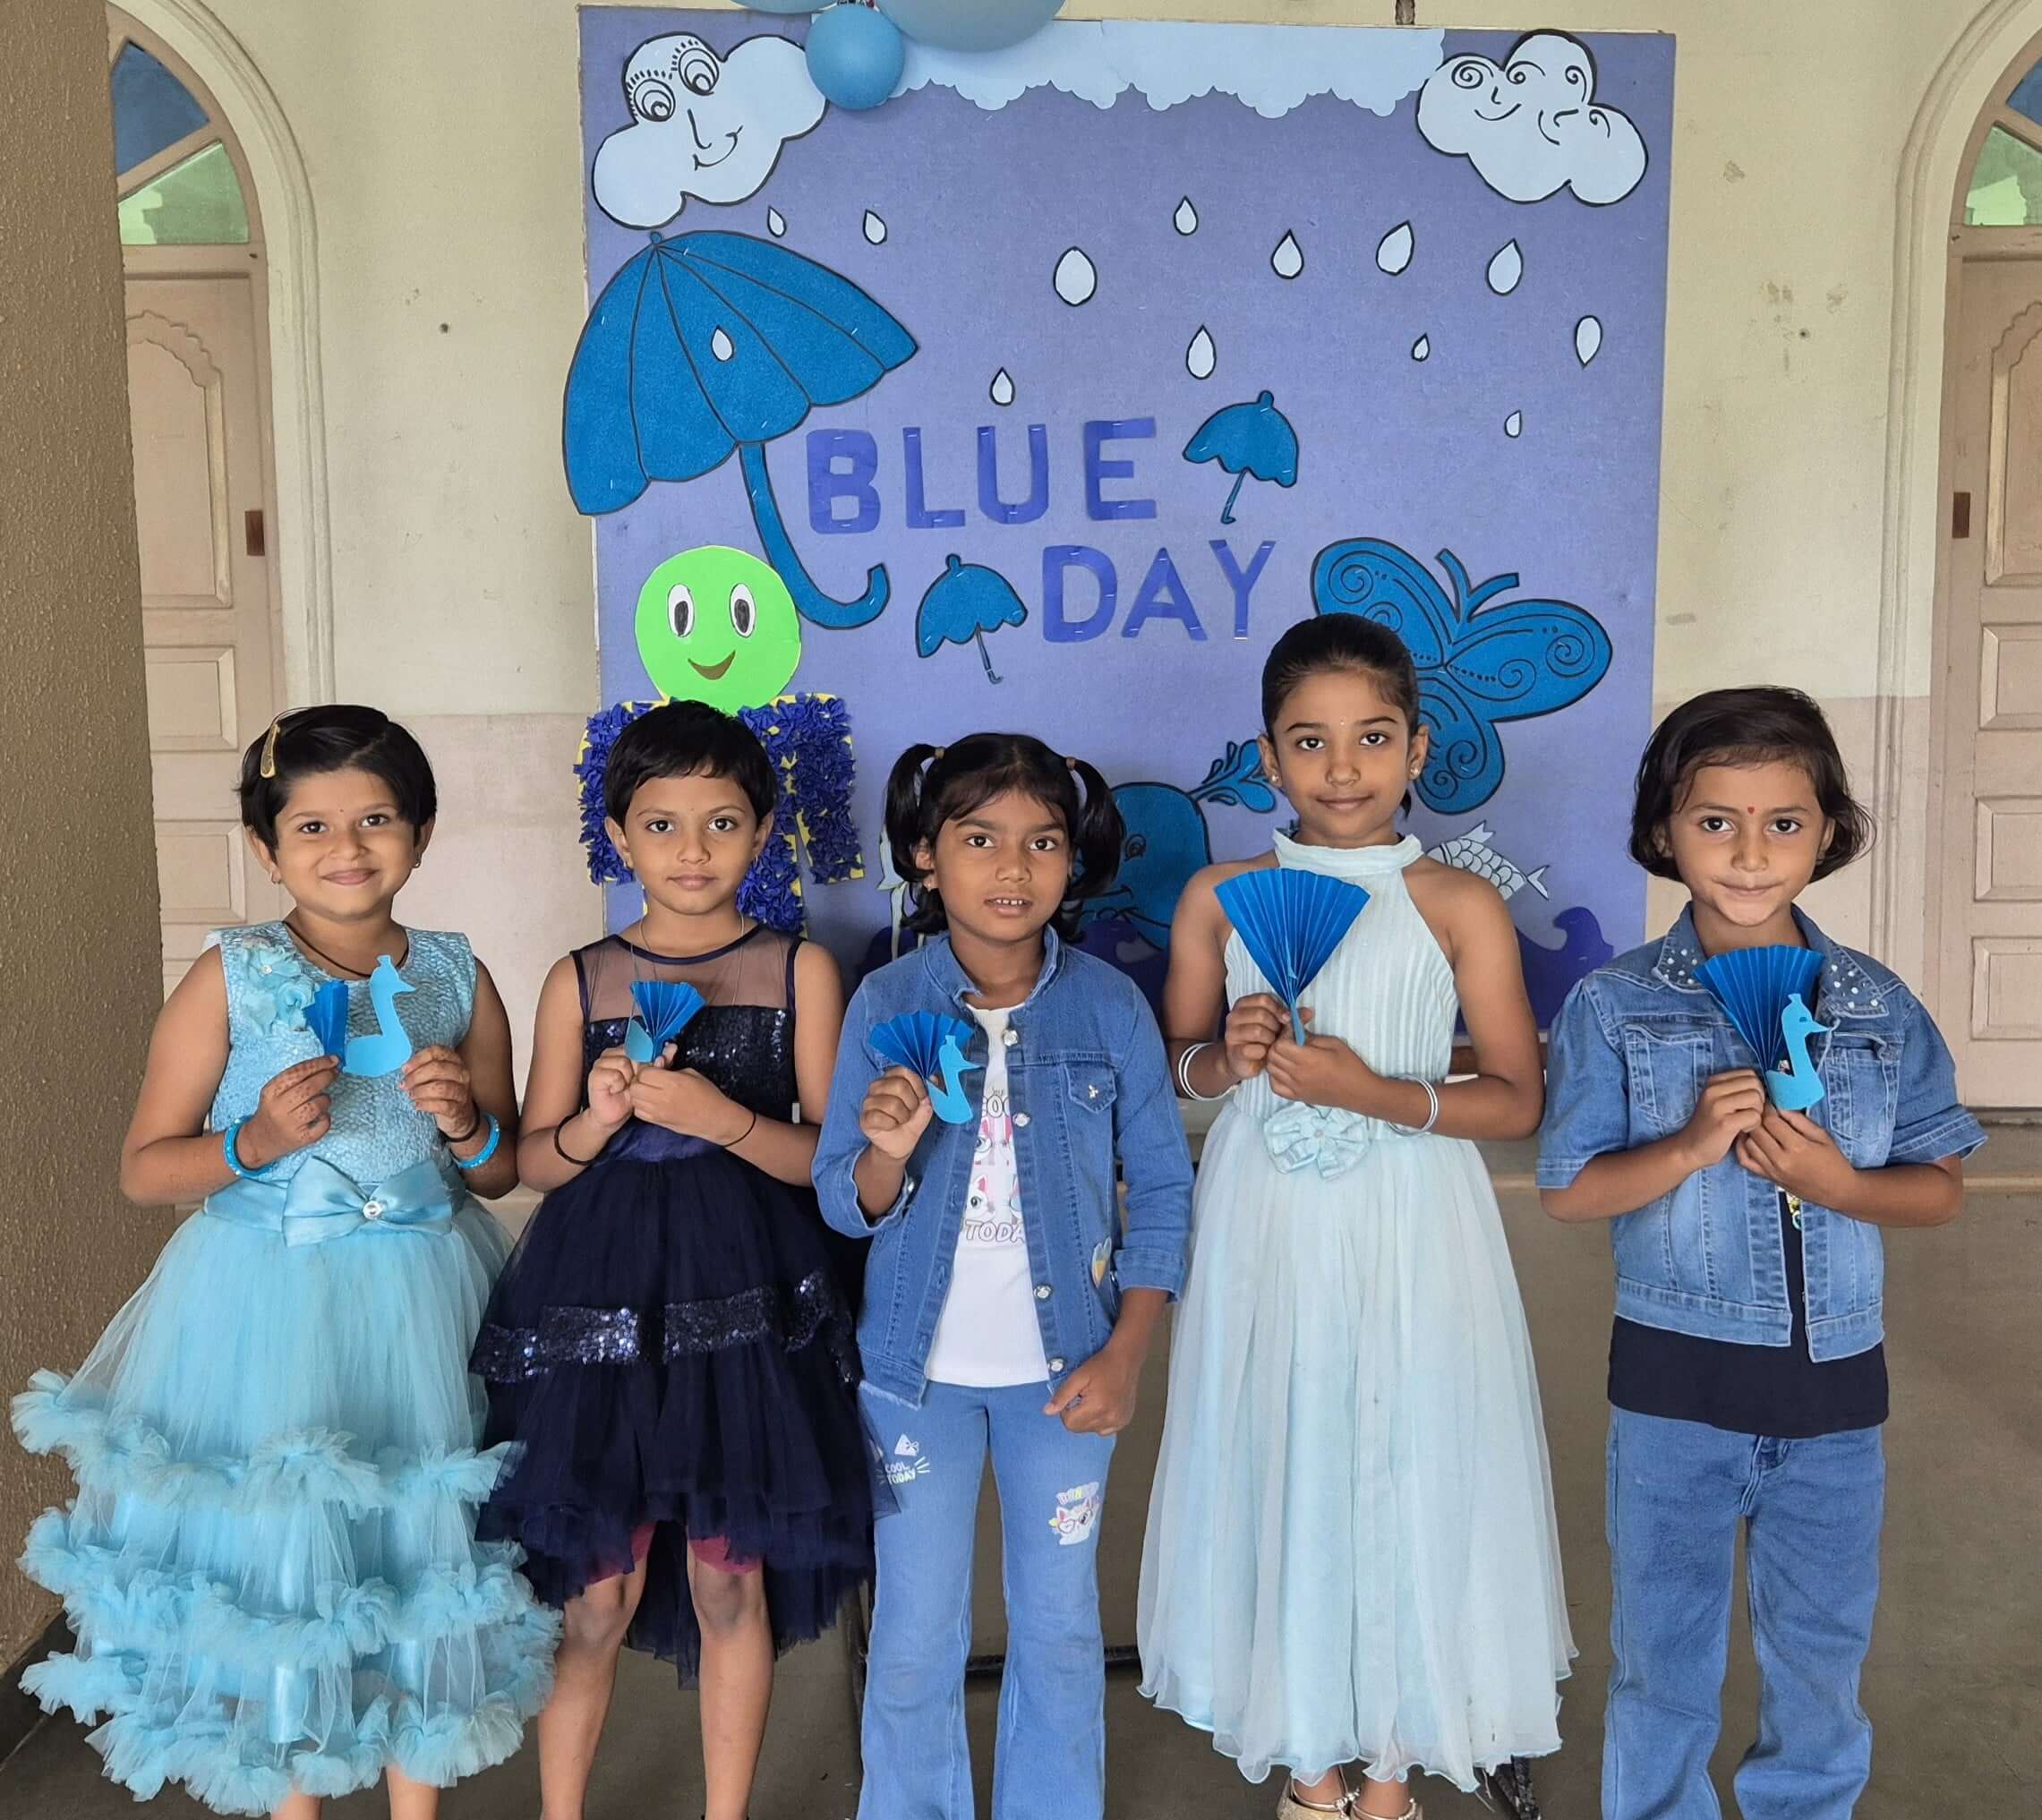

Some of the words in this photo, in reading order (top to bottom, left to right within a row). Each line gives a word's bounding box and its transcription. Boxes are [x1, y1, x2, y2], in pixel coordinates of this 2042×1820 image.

[807, 416, 1157, 534] BLUE
[1042, 539, 1276, 643] DAY
[965, 1218, 1025, 1243] TODA
